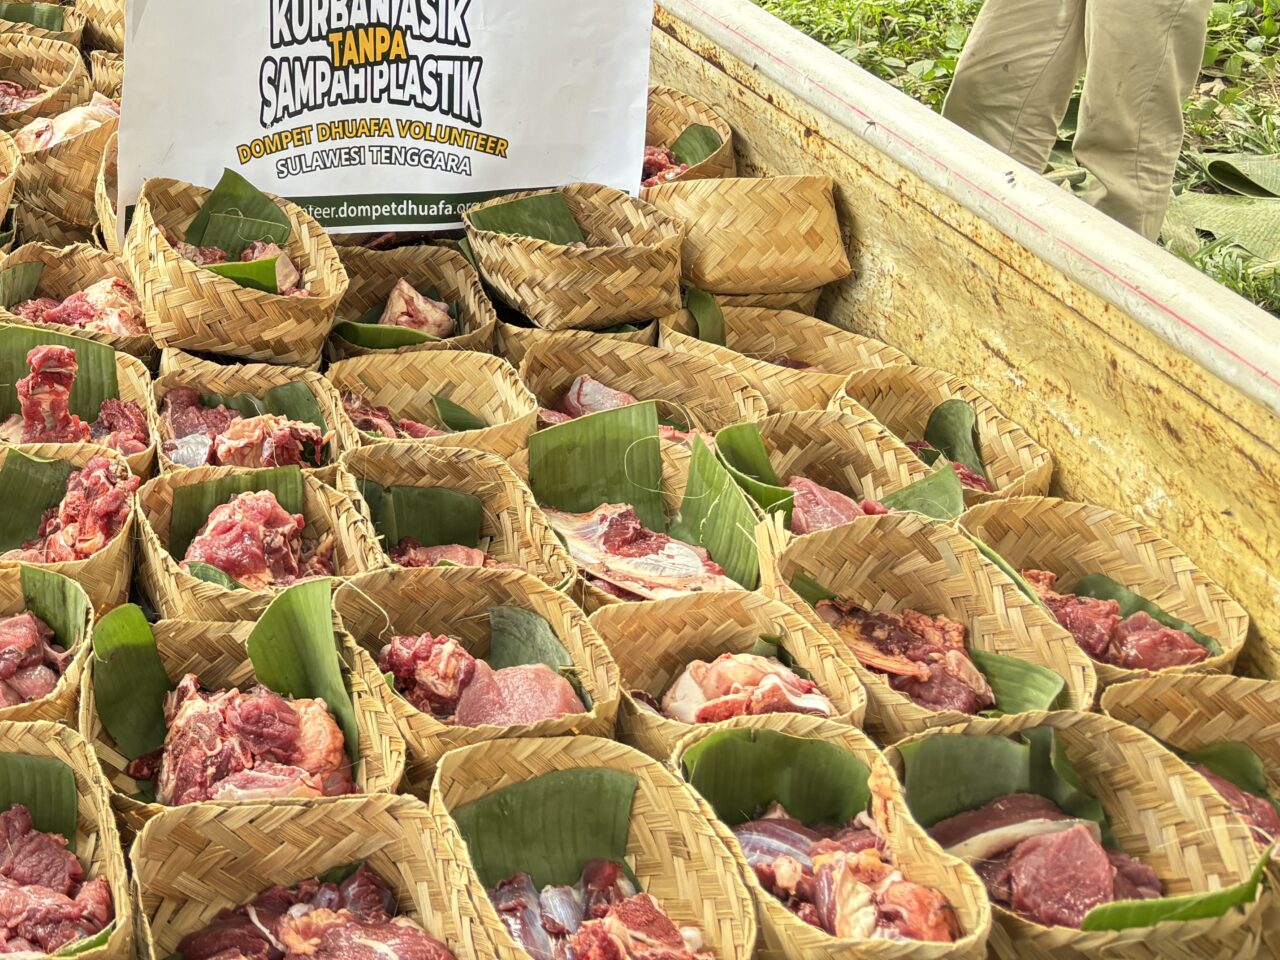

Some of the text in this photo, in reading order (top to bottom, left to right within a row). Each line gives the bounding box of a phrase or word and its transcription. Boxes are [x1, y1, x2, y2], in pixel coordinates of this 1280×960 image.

[327, 25, 408, 68] TANPA
[260, 54, 483, 128] SAMPAH PLASTIK
[236, 118, 509, 164] DOMPET DHUAFA VOLUNTEER
[276, 145, 471, 179] SULAWESI TENGGARA
